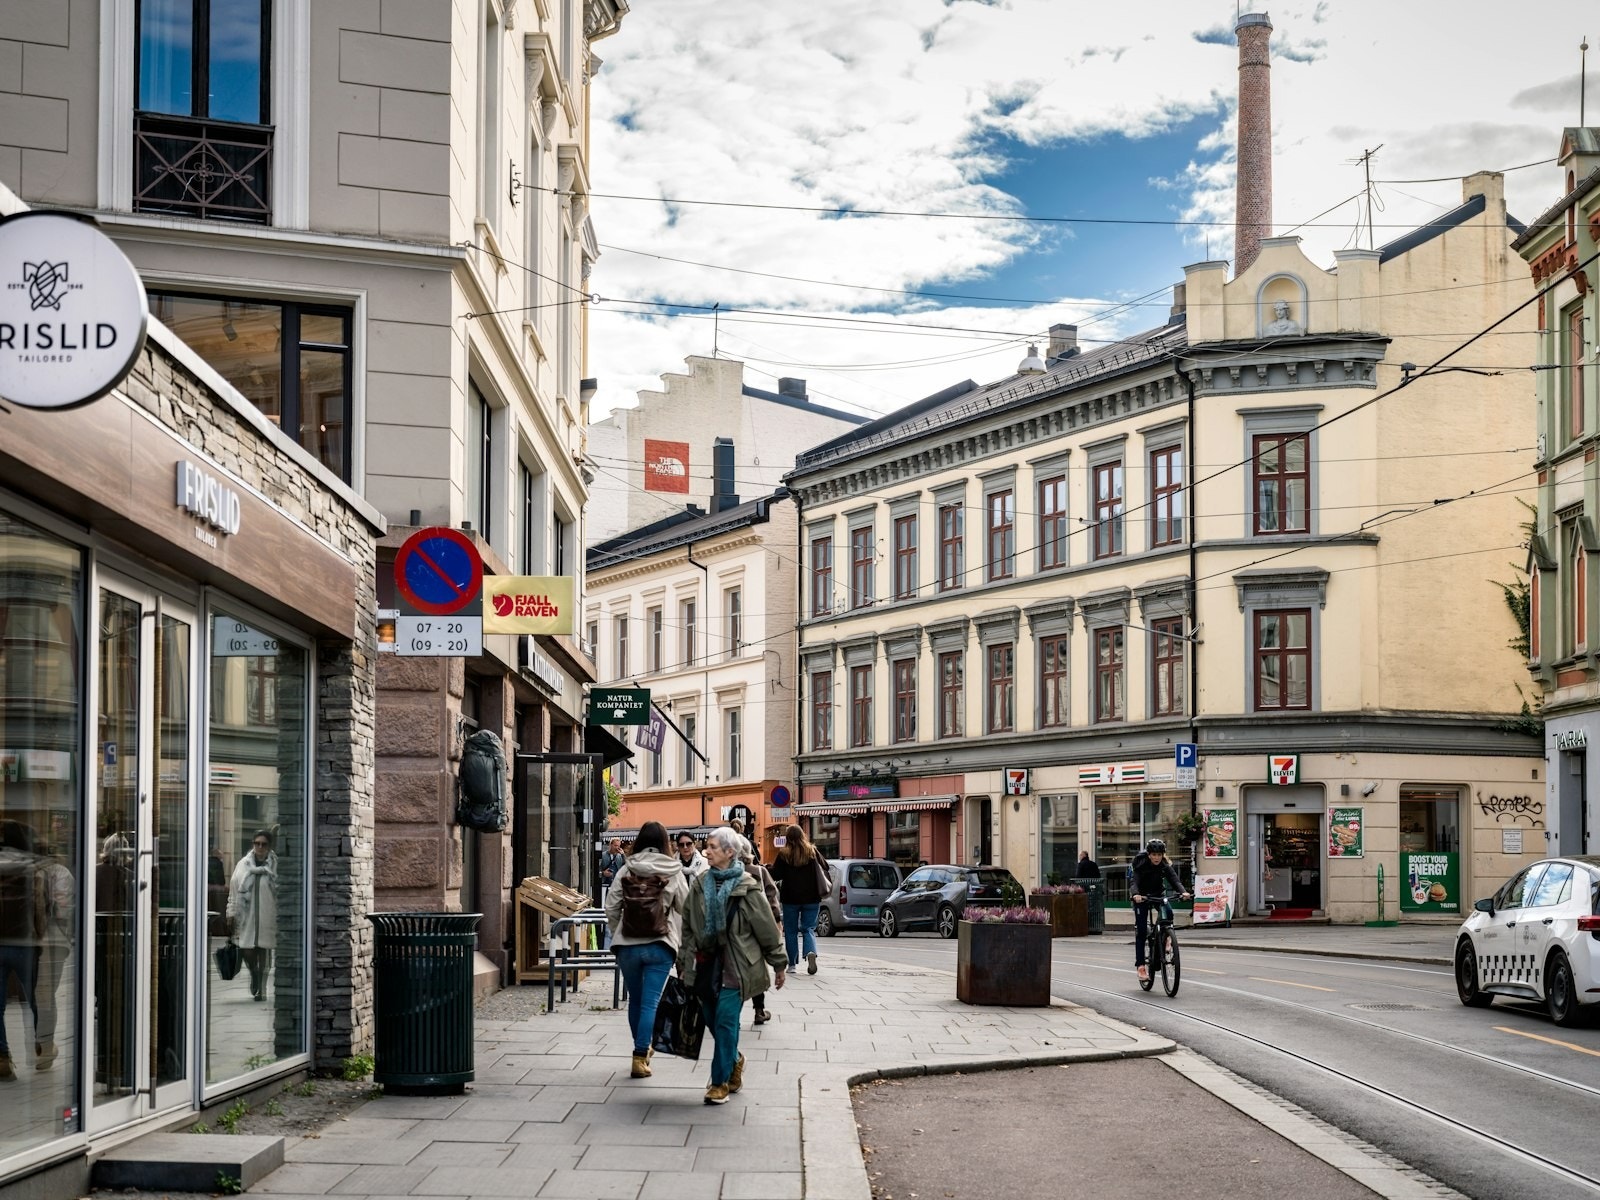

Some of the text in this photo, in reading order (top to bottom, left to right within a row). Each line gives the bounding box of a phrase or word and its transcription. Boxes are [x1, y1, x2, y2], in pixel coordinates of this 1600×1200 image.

[0, 323, 118, 350] RISLID
[18, 355, 73, 363] TAILORED
[659, 456, 673, 465] THE
[178, 460, 241, 536] FRISLID
[416, 623, 432, 633] 07
[447, 623, 463, 633] 20
[411, 638, 432, 651] (09
[448, 638, 468, 651] 20)
[1552, 729, 1587, 750] TARA
[1180, 746, 1192, 765] P
[1274, 758, 1294, 784] 7
[1009, 771, 1025, 795] 7
[1408, 855, 1448, 863] BOOST YOUR
[1408, 863, 1448, 876] ENERGY
